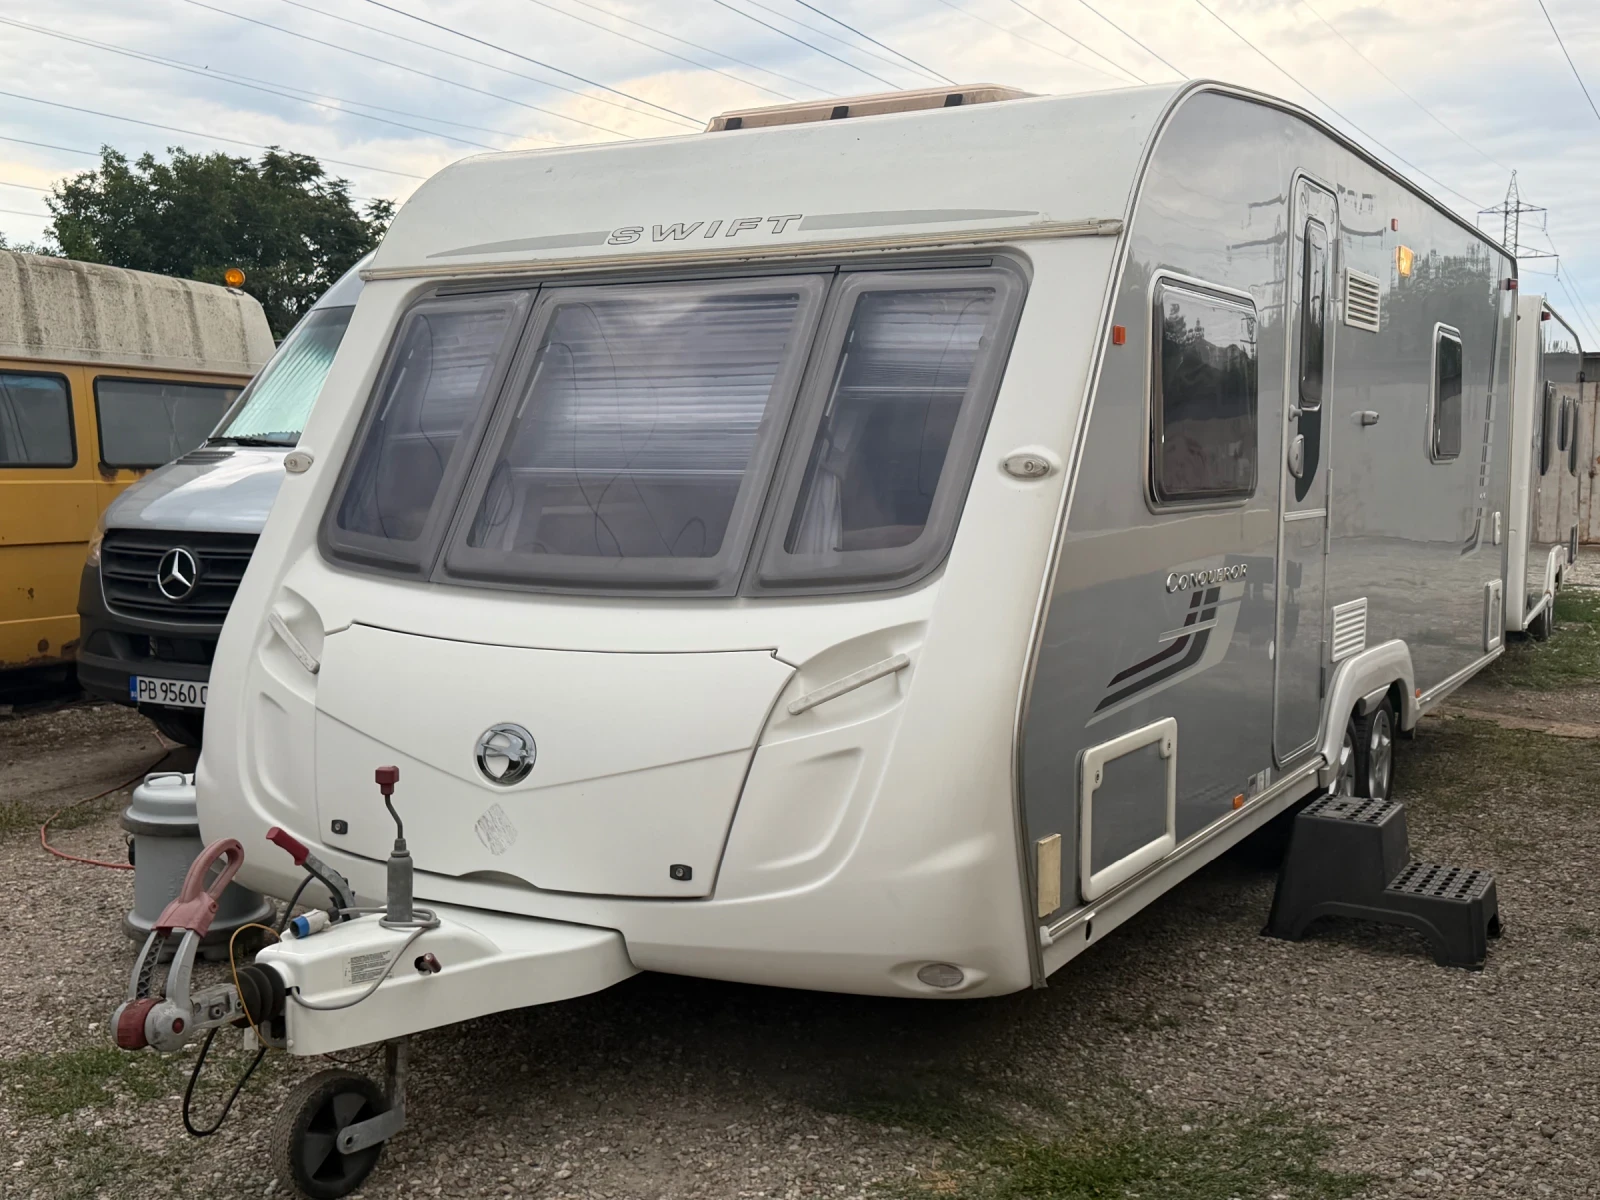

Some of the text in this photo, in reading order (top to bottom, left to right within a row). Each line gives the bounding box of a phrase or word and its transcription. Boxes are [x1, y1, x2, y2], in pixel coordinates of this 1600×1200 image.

[607, 214, 803, 245] SWIFT
[1165, 563, 1248, 594] CONQUEROR
[139, 680, 157, 700] PB
[160, 682, 197, 704] 9560
